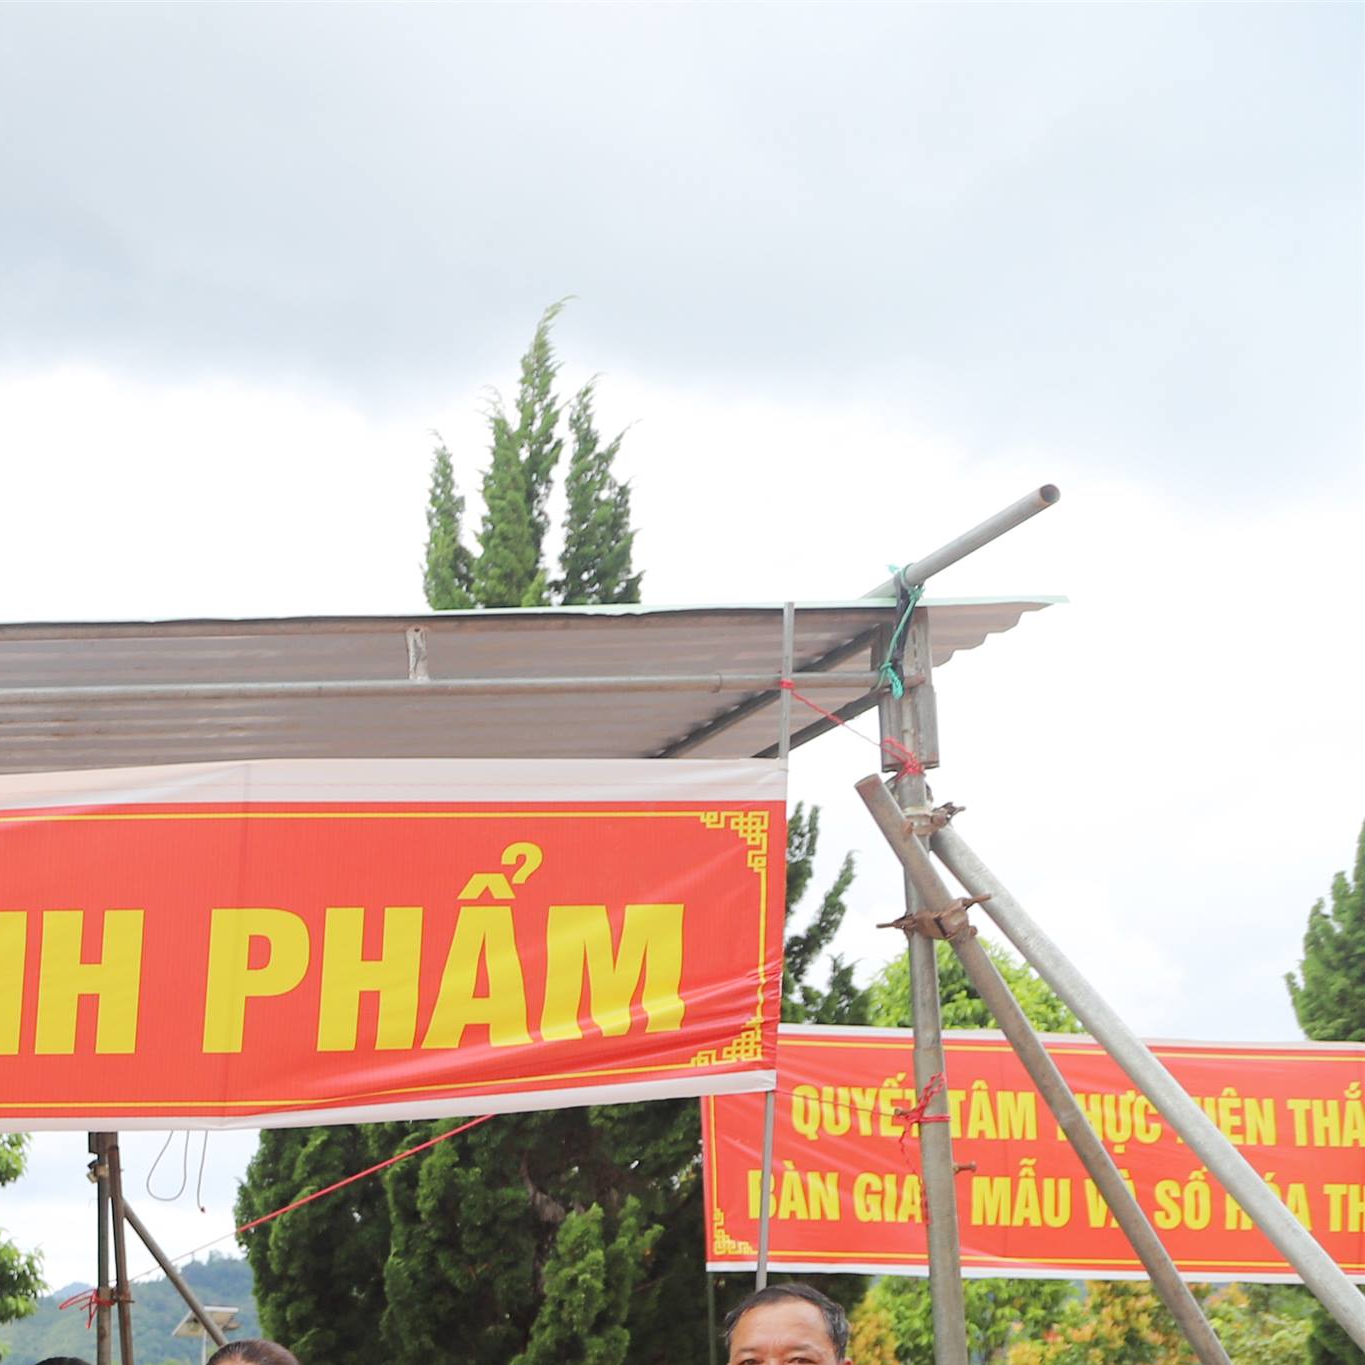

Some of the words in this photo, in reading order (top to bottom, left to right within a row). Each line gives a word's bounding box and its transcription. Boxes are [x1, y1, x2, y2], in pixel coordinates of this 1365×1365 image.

[203, 842, 686, 1054] PHẨM
[1057, 1090, 1163, 1154] HỰC
[971, 1157, 1071, 1228] MẪU
